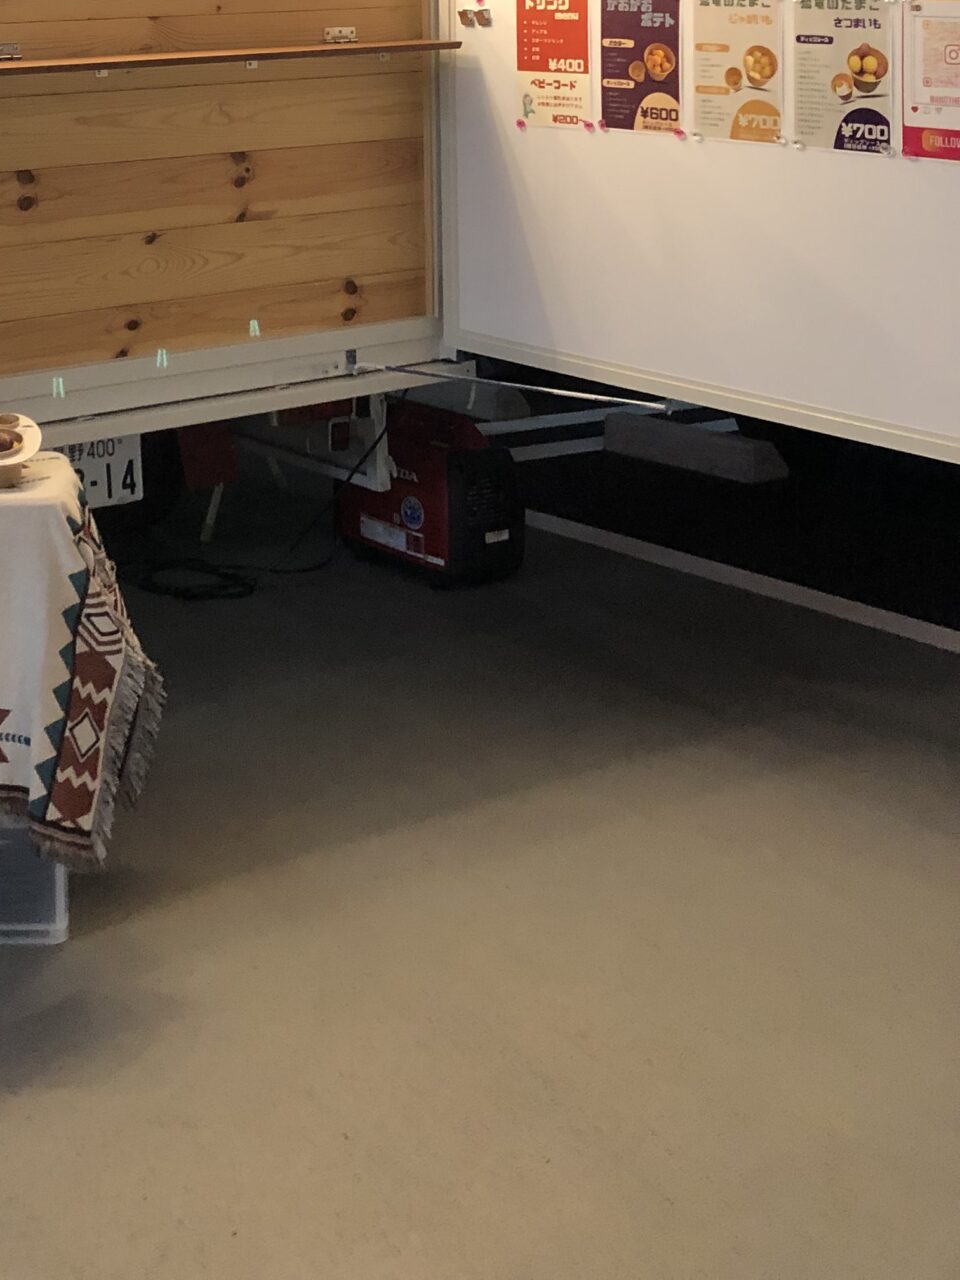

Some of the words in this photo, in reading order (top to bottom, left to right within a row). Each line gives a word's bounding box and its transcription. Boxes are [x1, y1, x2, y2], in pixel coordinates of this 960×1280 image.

[640, 12, 675, 28] ポテト
[834, 17, 882, 29] さつまいも
[548, 58, 584, 73] ¥400
[640, 106, 679, 122] ¥600
[841, 122, 889, 140] ¥700
